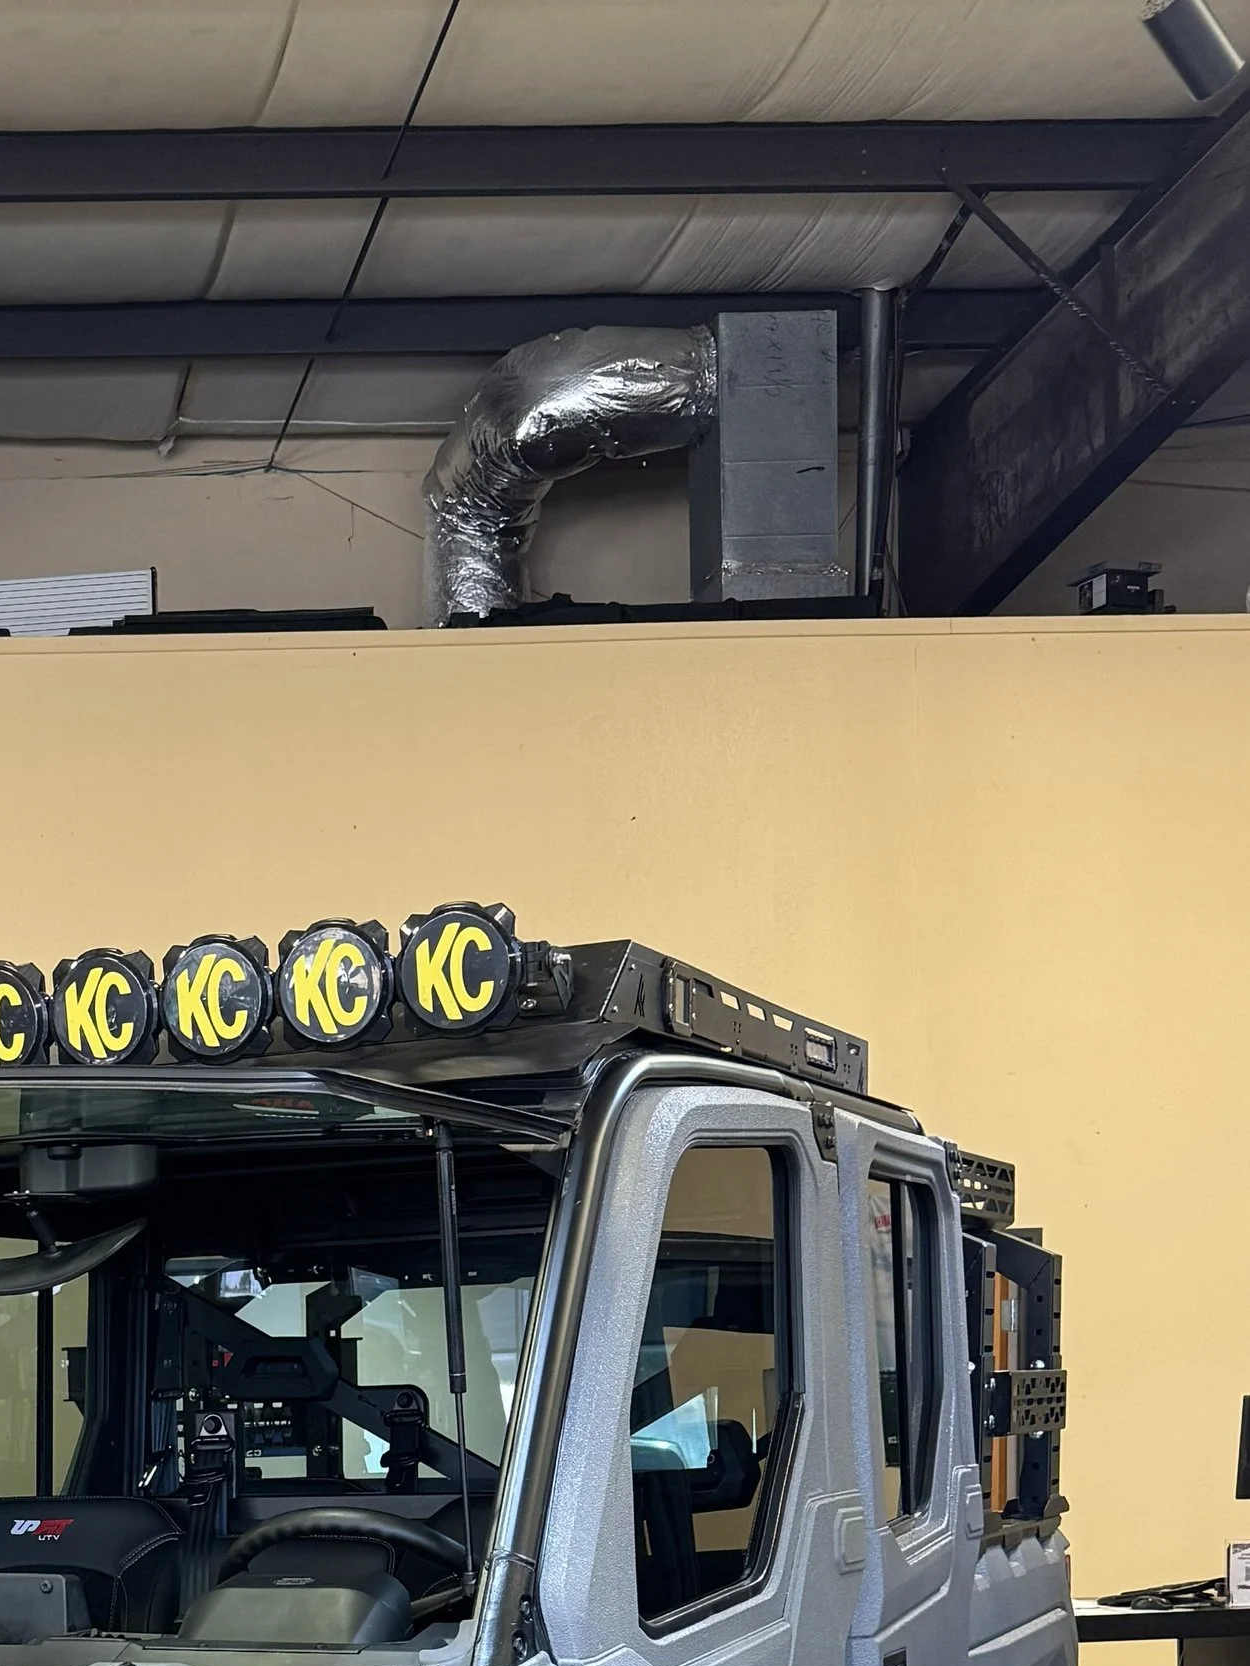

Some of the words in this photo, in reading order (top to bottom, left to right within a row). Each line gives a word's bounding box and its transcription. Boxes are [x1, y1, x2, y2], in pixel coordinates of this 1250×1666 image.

[64, 966, 135, 1058] KC
[176, 954, 249, 1047] KC
[291, 937, 368, 1033] KC
[414, 922, 494, 1021] KC
